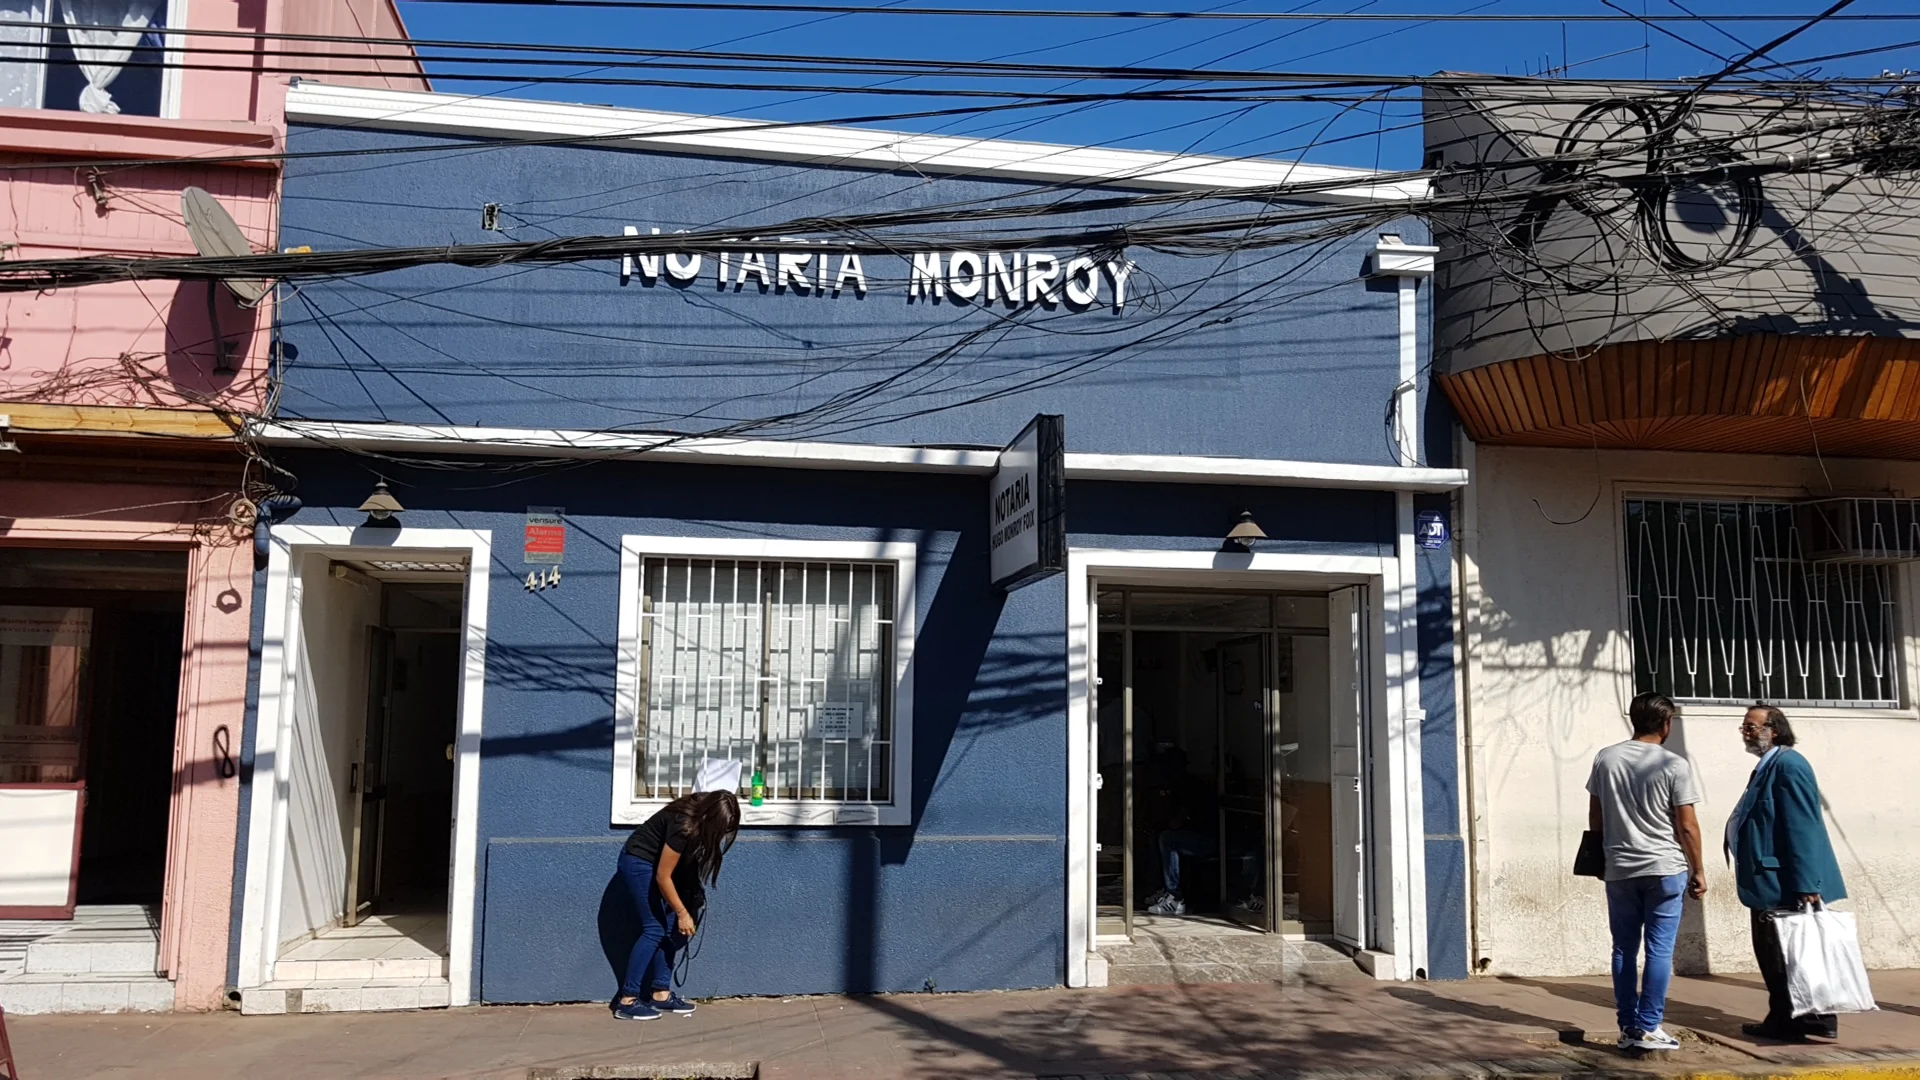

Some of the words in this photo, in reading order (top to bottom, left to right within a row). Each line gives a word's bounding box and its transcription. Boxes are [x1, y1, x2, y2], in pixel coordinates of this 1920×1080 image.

[622, 226, 868, 293] NOTARIA
[909, 251, 1136, 308] MONROY
[995, 473, 1030, 526] NOTARIA
[529, 527, 562, 536] Alarma
[1419, 522, 1443, 536] ADT
[524, 565, 561, 591] 414
